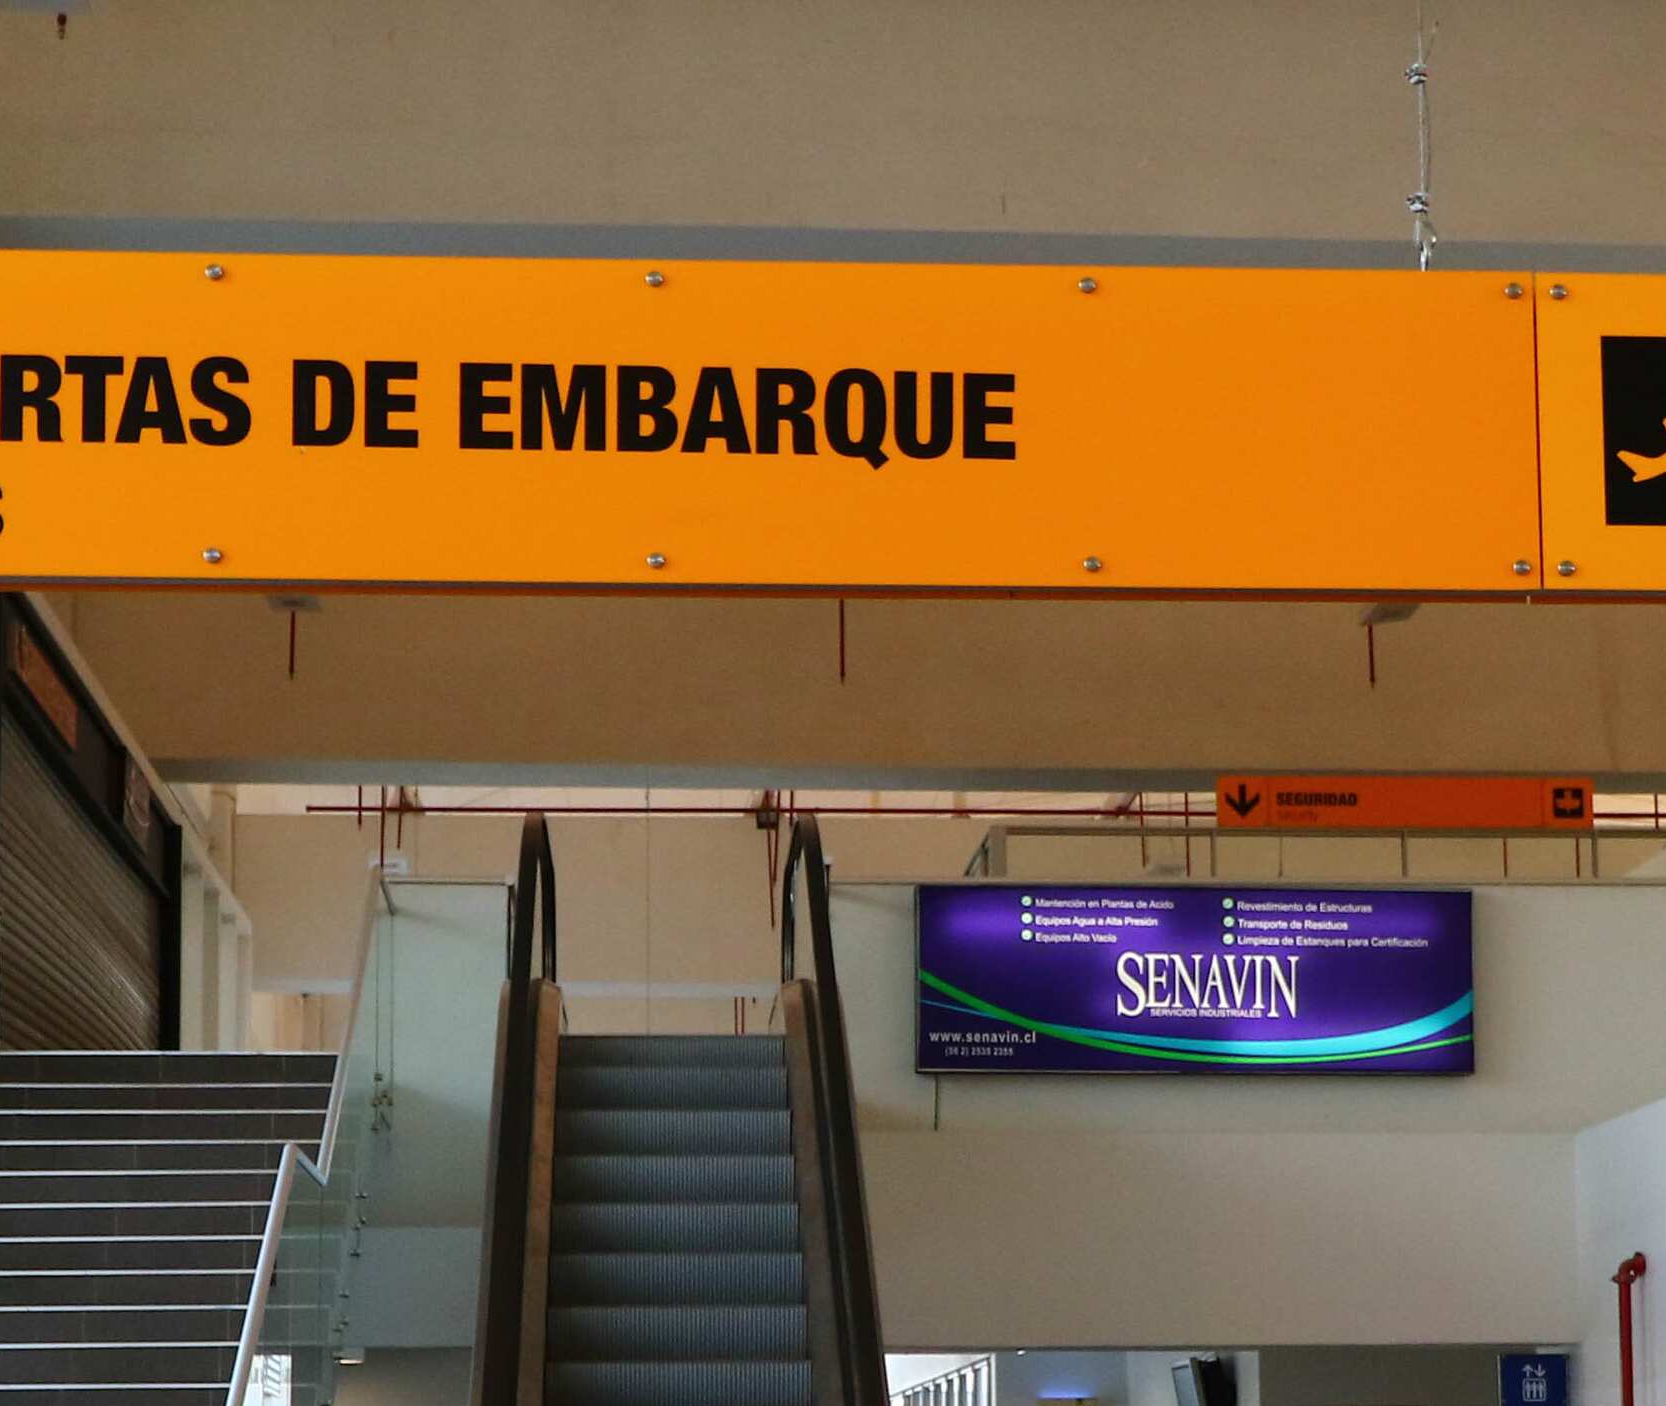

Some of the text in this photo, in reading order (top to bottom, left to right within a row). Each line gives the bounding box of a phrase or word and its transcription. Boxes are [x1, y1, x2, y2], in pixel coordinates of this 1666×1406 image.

[291, 358, 420, 449] DE
[458, 362, 1017, 471] EMBARQUE
[1276, 792, 1357, 806] SEGURIDAD
[1101, 899, 1134, 909] Plantas
[1135, 900, 1148, 909] de
[1236, 901, 1373, 914] Revestimiento de Estructuras
[1035, 915, 1071, 927] Equipos
[1072, 916, 1096, 927] Agua
[1105, 916, 1123, 926] Alta
[1237, 918, 1348, 931] Transporte de Residuos
[1035, 932, 1071, 943] Equipos
[1072, 933, 1090, 942] Alto
[1237, 935, 1280, 946] Limpieza
[1281, 936, 1294, 946] de
[1296, 936, 1346, 948] Estanques
[1347, 938, 1369, 949] para
[1116, 951, 1300, 1019] SENAVIN
[1150, 1008, 1262, 1018] SERVICIOS INDUSTRIALES
[928, 1030, 1037, 1043] www.senavin.cl
